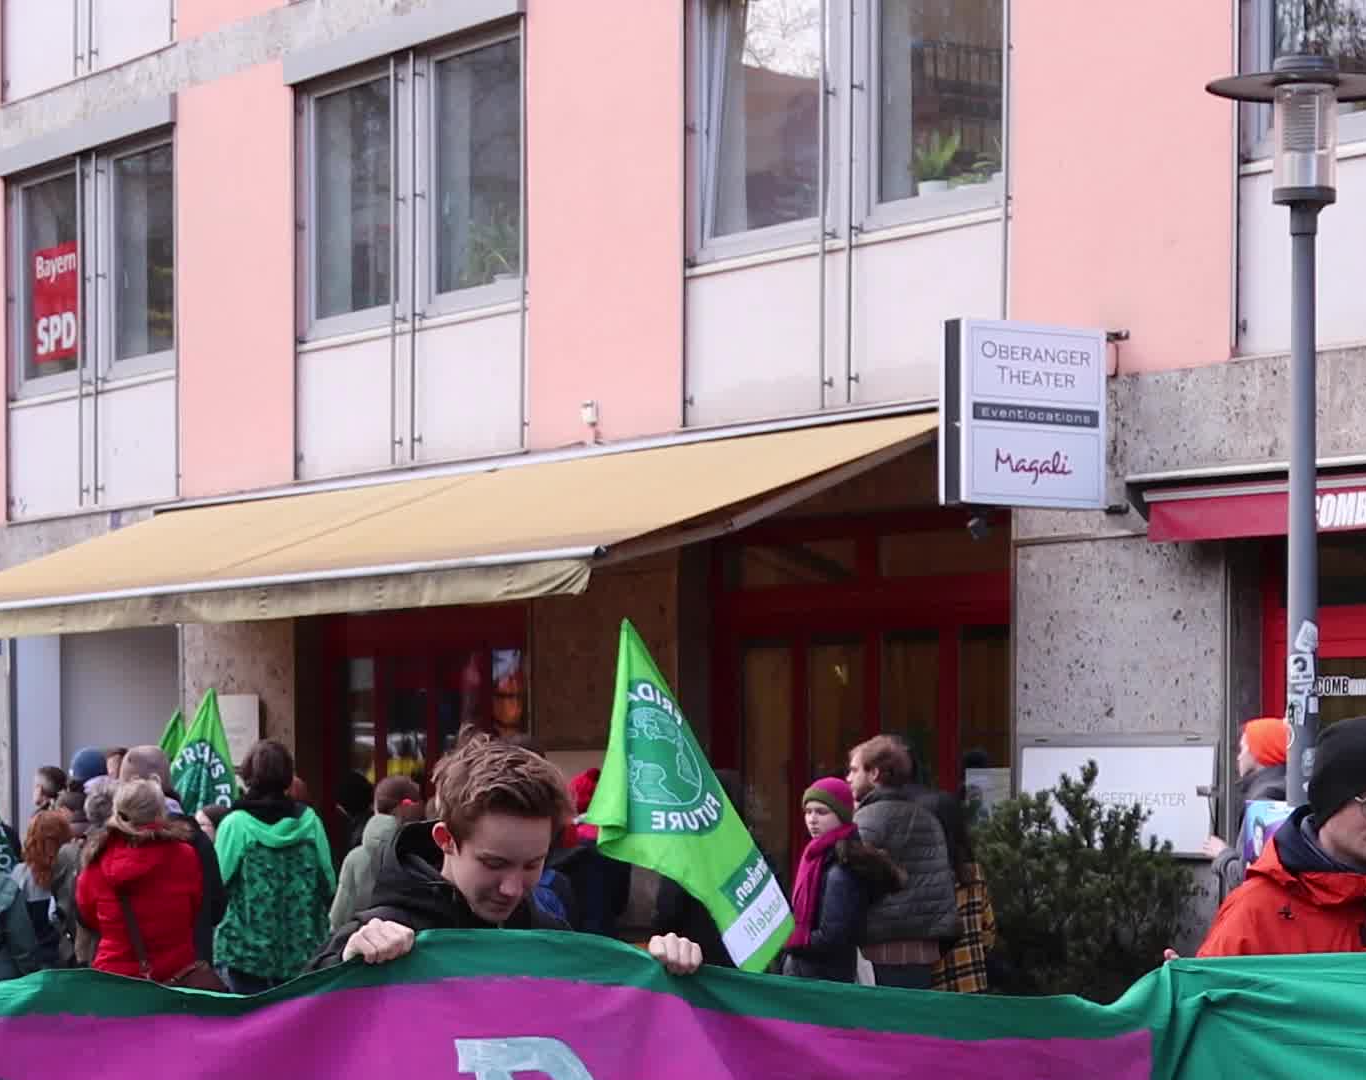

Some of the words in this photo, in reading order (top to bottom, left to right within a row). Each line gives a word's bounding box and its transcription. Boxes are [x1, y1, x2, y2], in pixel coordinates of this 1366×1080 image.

[35, 253, 76, 283] Bayern
[37, 311, 76, 355] SPD
[981, 340, 1091, 367] OBERANGER
[996, 365, 1076, 389] THEATER
[981, 407, 1091, 424] Eventlocations
[994, 447, 1073, 485] Magali
